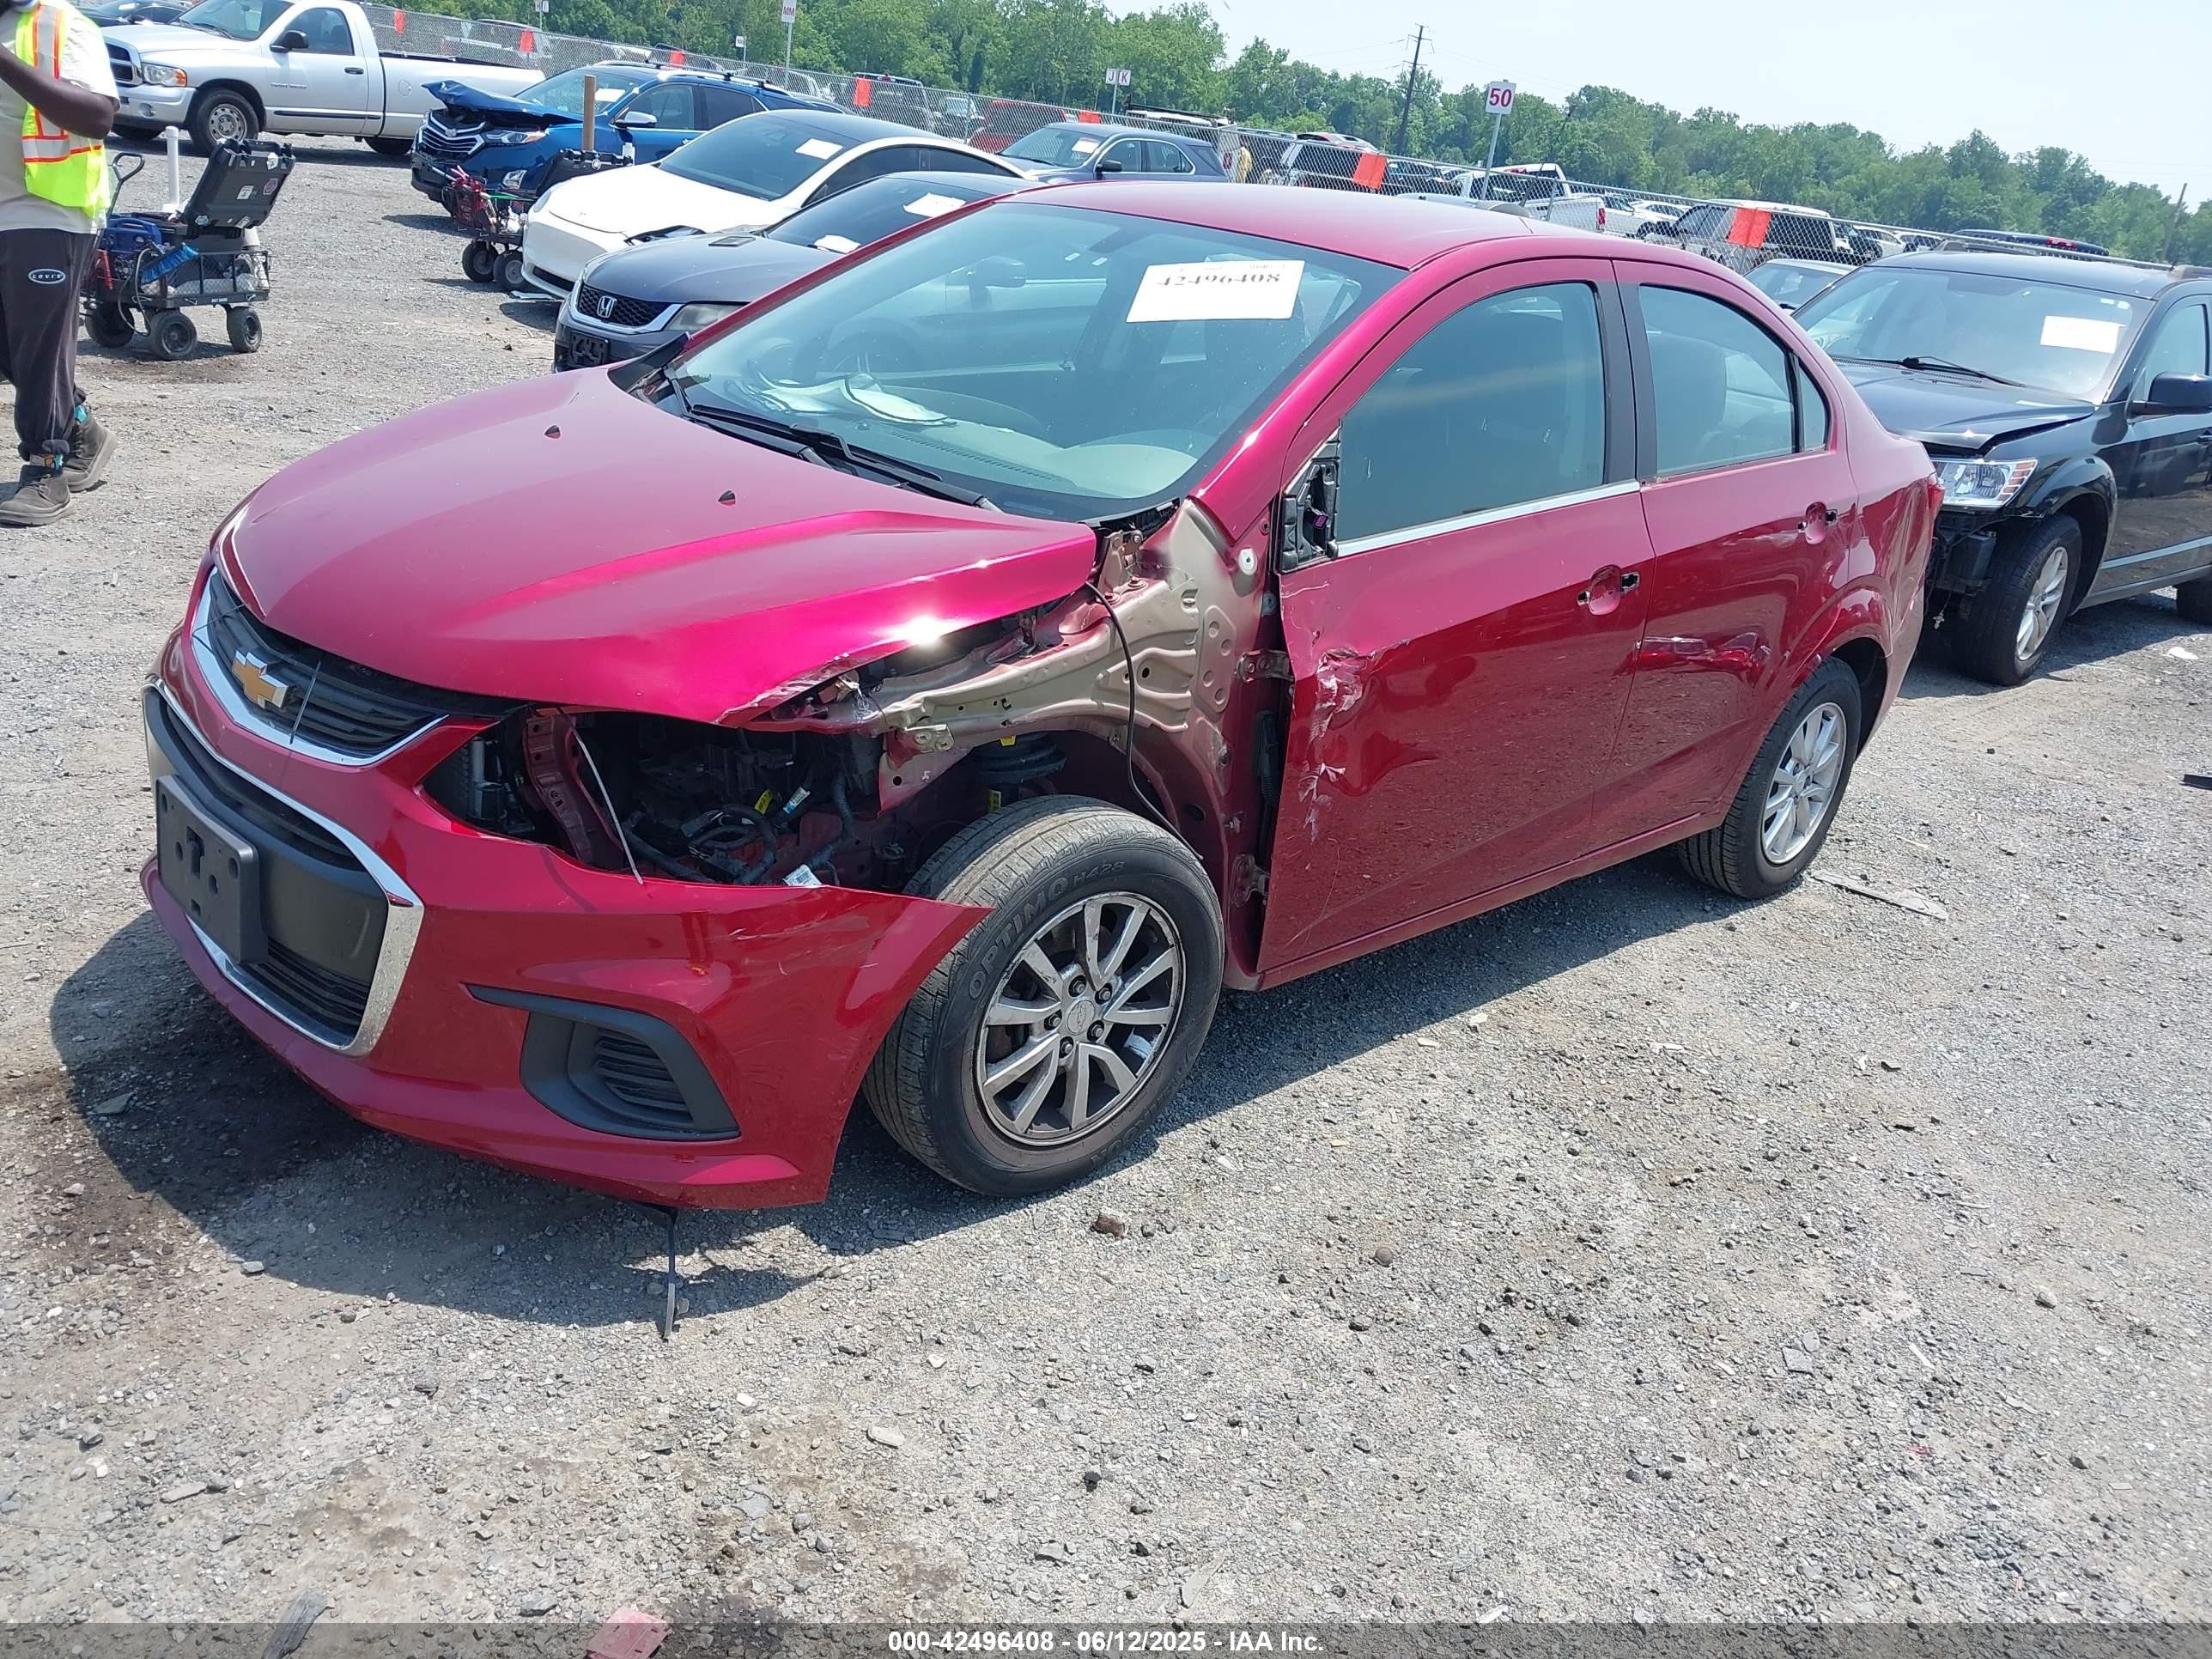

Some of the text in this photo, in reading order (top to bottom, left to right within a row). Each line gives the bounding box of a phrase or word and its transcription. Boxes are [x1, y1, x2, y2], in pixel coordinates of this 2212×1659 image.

[1109, 70, 1129, 83] J K
[1489, 88, 1512, 107] 50
[968, 877, 1068, 1000] OPTIMO
